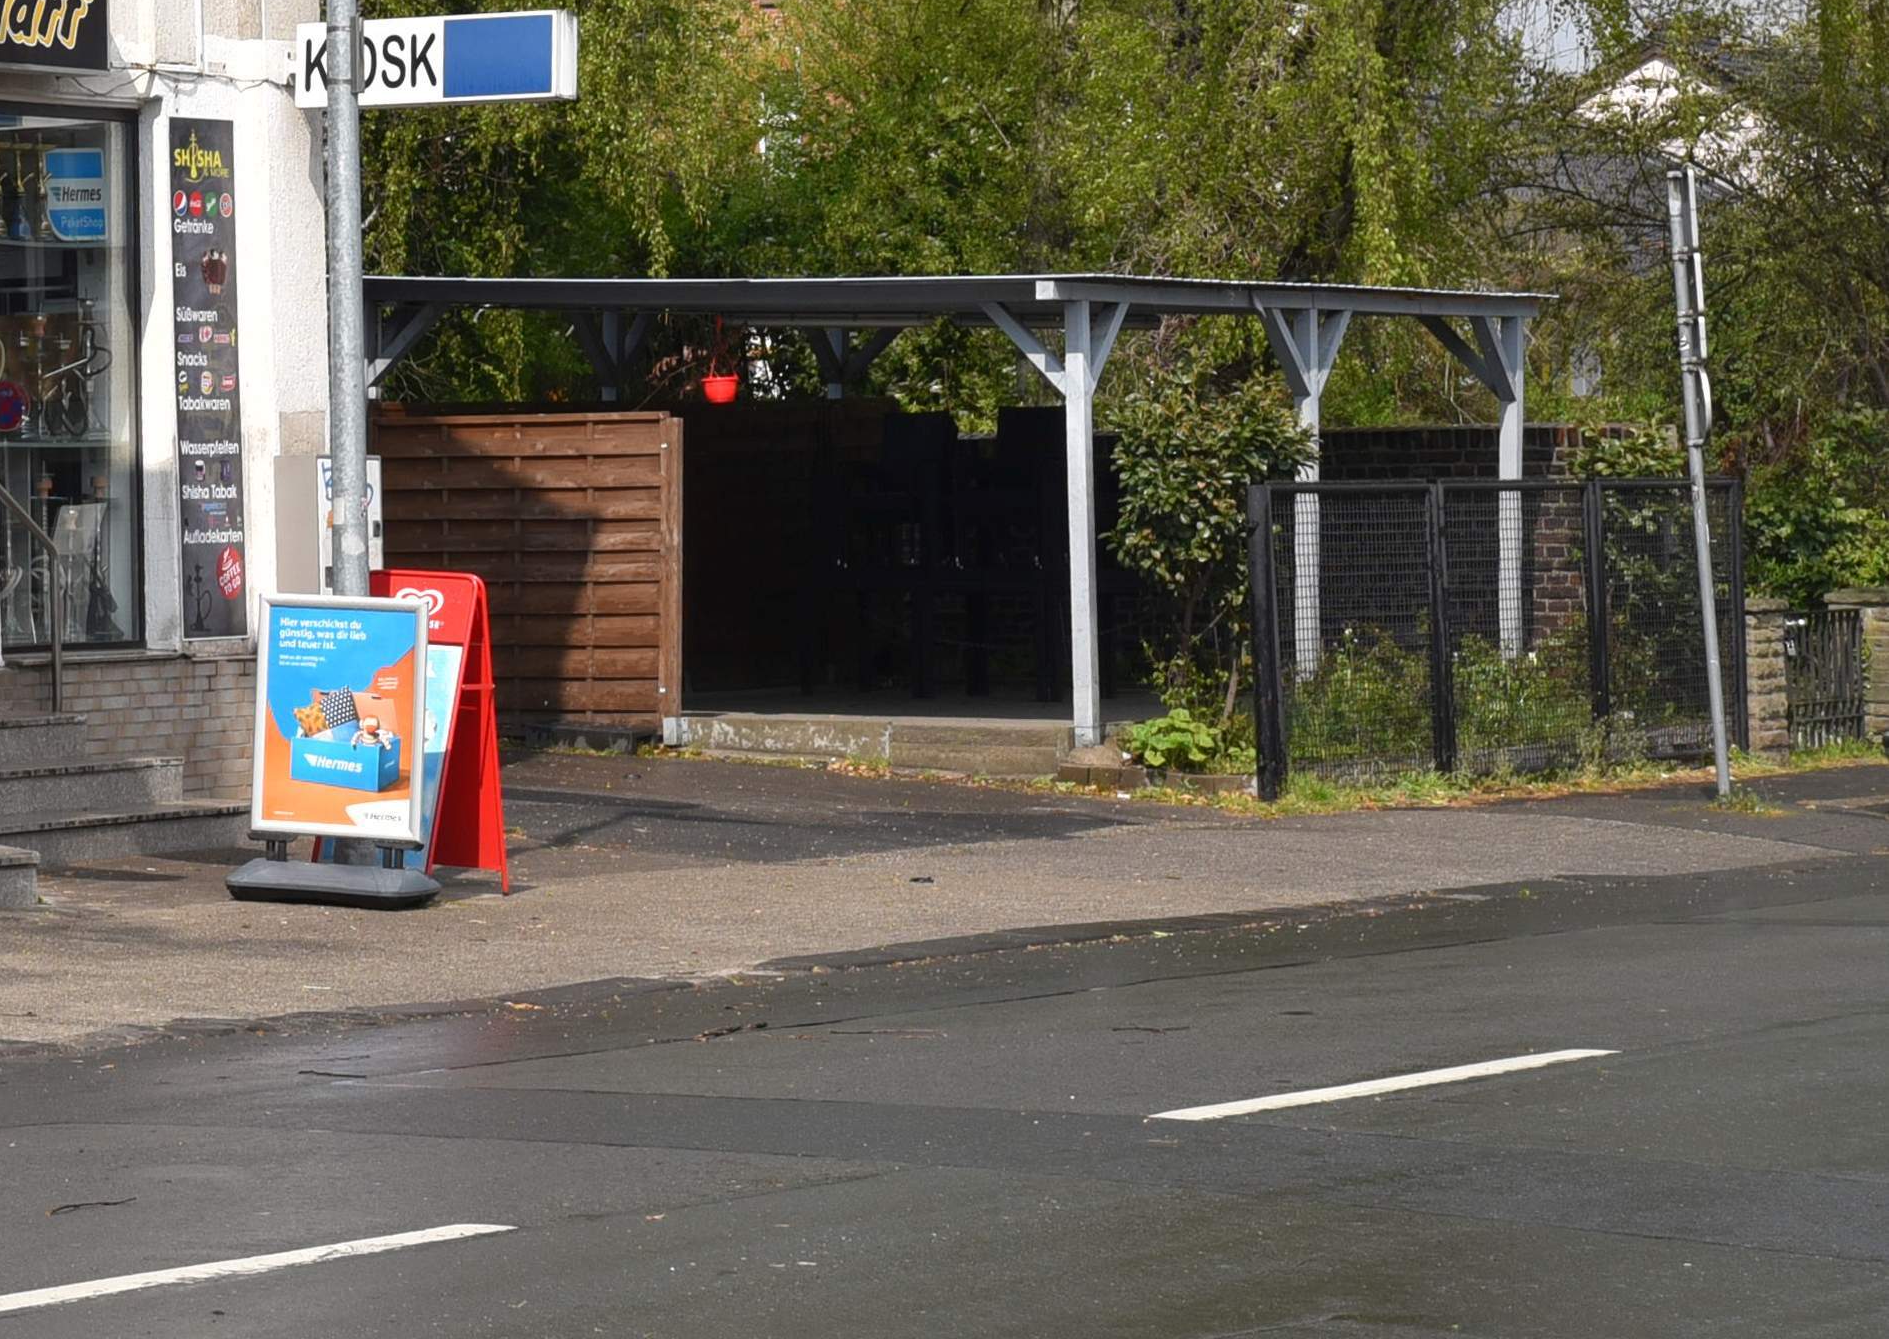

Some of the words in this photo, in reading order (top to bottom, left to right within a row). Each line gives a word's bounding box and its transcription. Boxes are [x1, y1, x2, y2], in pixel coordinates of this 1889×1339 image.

[305, 33, 437, 92] KSK
[62, 186, 102, 202] Hermes
[173, 218, 214, 234] Getränke
[175, 262, 187, 278] Eis
[176, 306, 218, 322] Süßwaren
[177, 351, 208, 366] Snacks
[178, 395, 231, 411] Tabakwaren
[180, 440, 239, 458] Wasserpfeifen
[182, 484, 209, 499] Shisha
[211, 483, 238, 499] Tabak
[184, 528, 243, 544] Aufladekarten
[280, 617, 298, 627] Hier
[300, 618, 348, 629] verschickst
[349, 619, 362, 629] du
[316, 631, 334, 639] was
[316, 755, 363, 773] Hermes
